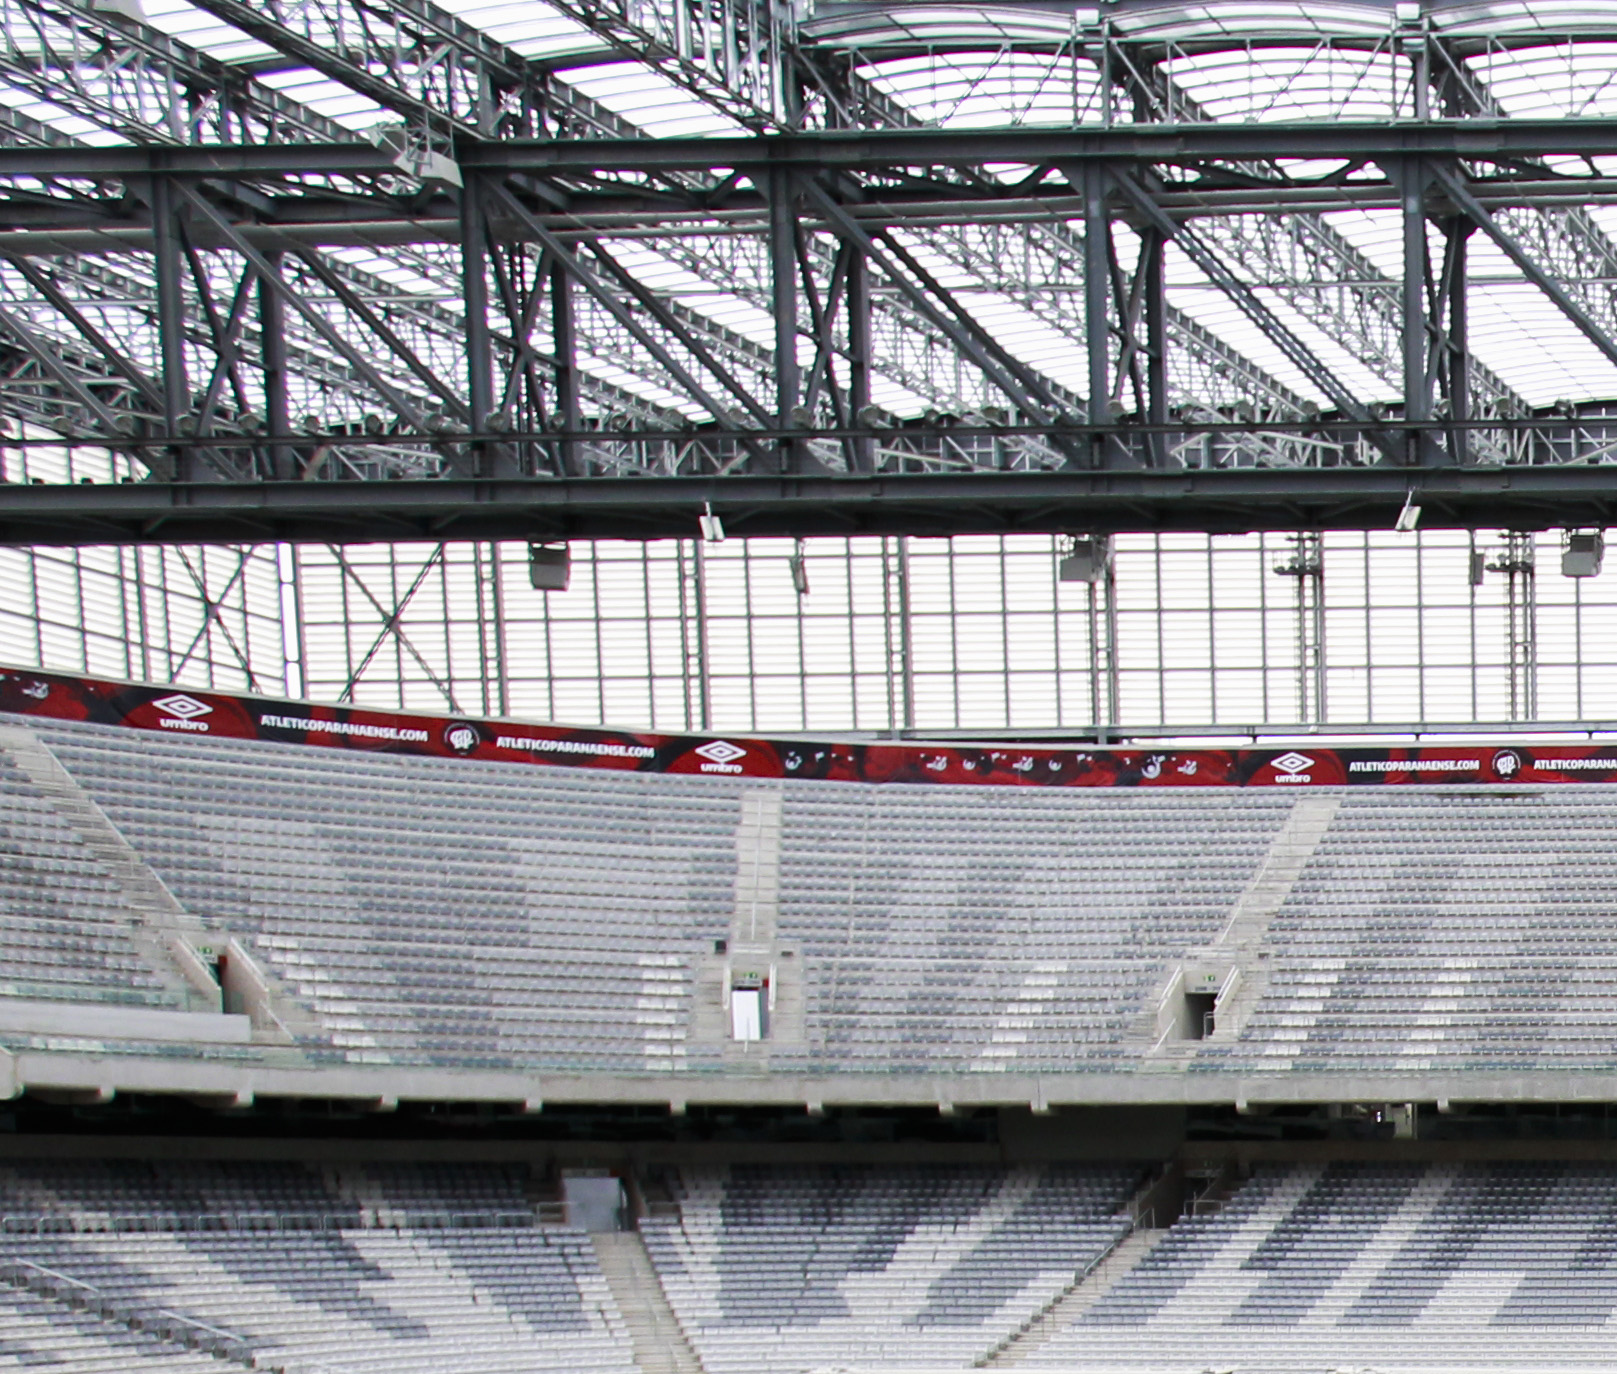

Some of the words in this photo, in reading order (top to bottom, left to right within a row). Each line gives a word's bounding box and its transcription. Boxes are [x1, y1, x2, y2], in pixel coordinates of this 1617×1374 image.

[160, 717, 208, 732] umbro
[260, 714, 428, 742] ATLETICOPARANAENSE.COM
[496, 736, 655, 759] ATLETICOPARANAENSE.COM
[701, 763, 743, 774] umbro
[1349, 758, 1480, 773] ATLETICOPARANAENSE.COM
[1275, 772, 1311, 785] umbro
